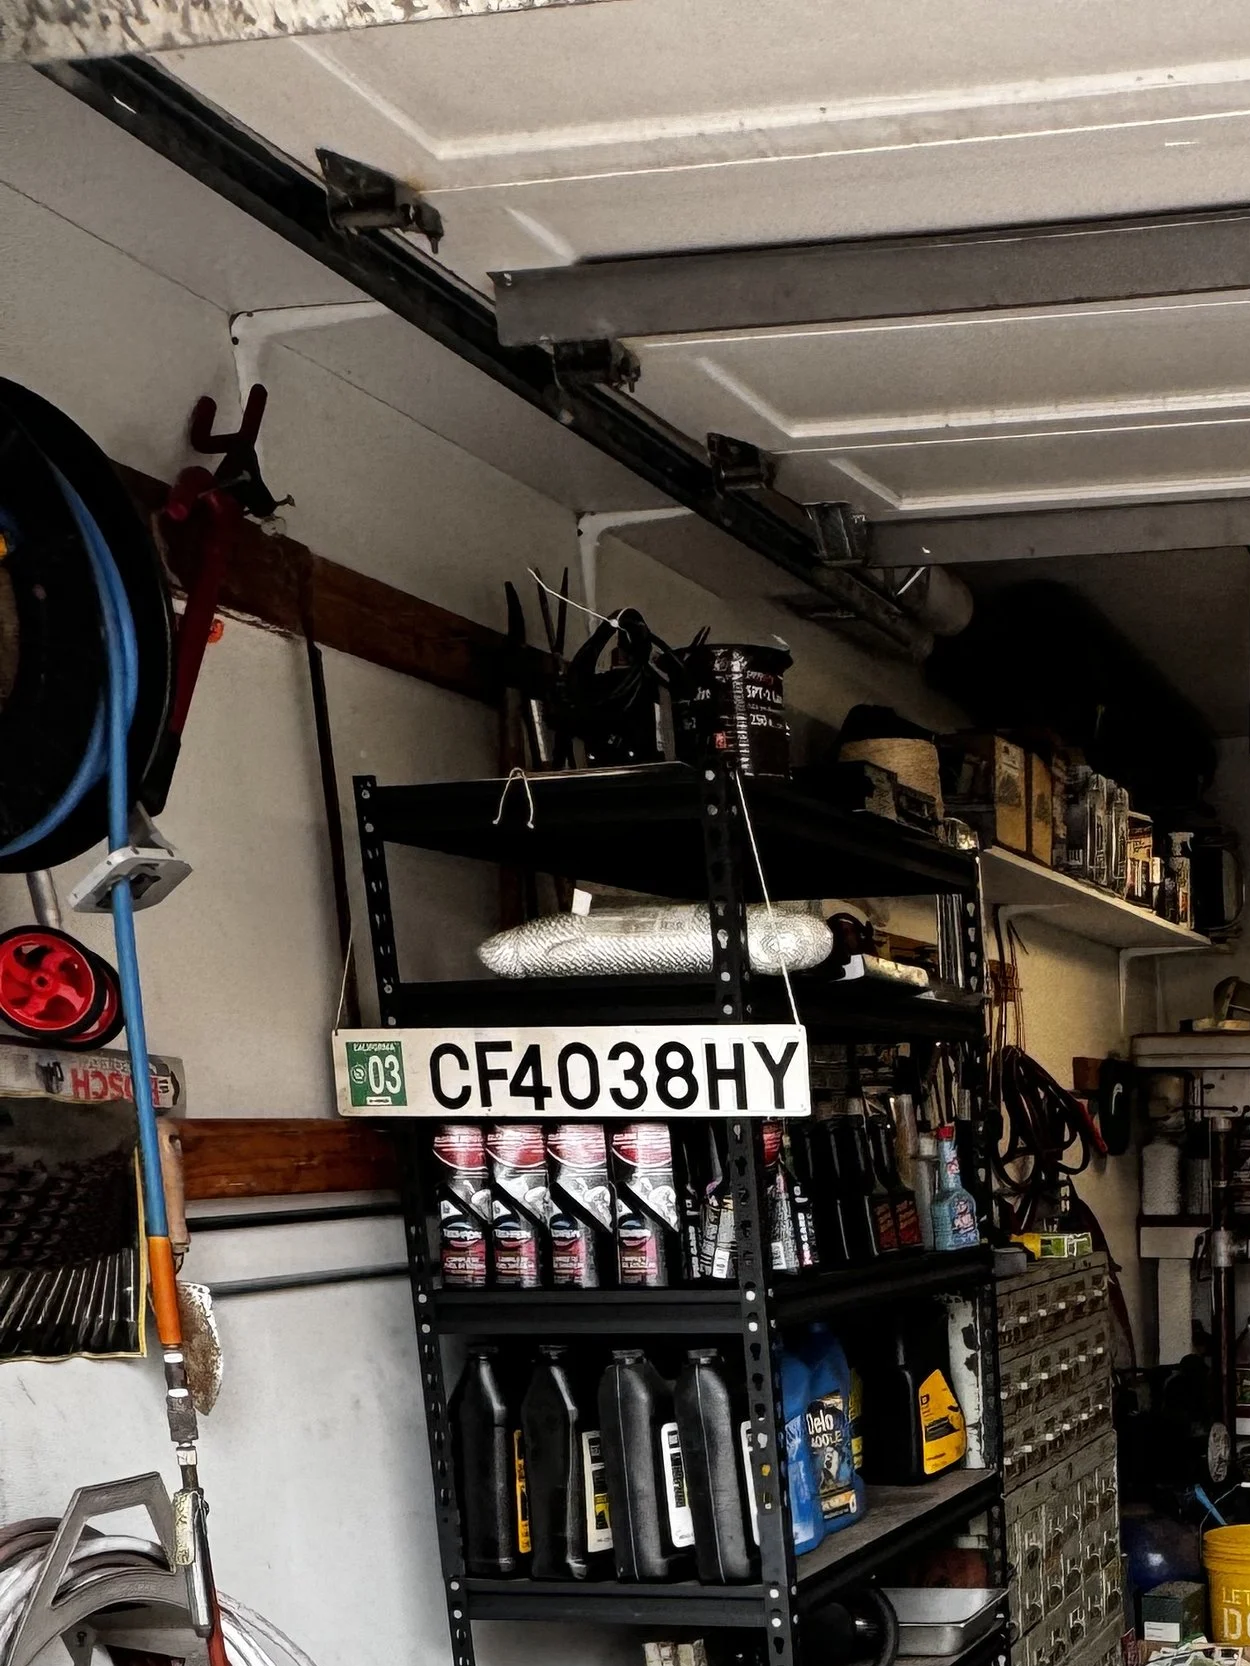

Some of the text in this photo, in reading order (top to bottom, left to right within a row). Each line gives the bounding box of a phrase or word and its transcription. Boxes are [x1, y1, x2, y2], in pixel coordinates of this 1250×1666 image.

[368, 1054, 402, 1095] 03
[430, 1040, 799, 1111] CF4038HY
[806, 1409, 834, 1436] Delo
